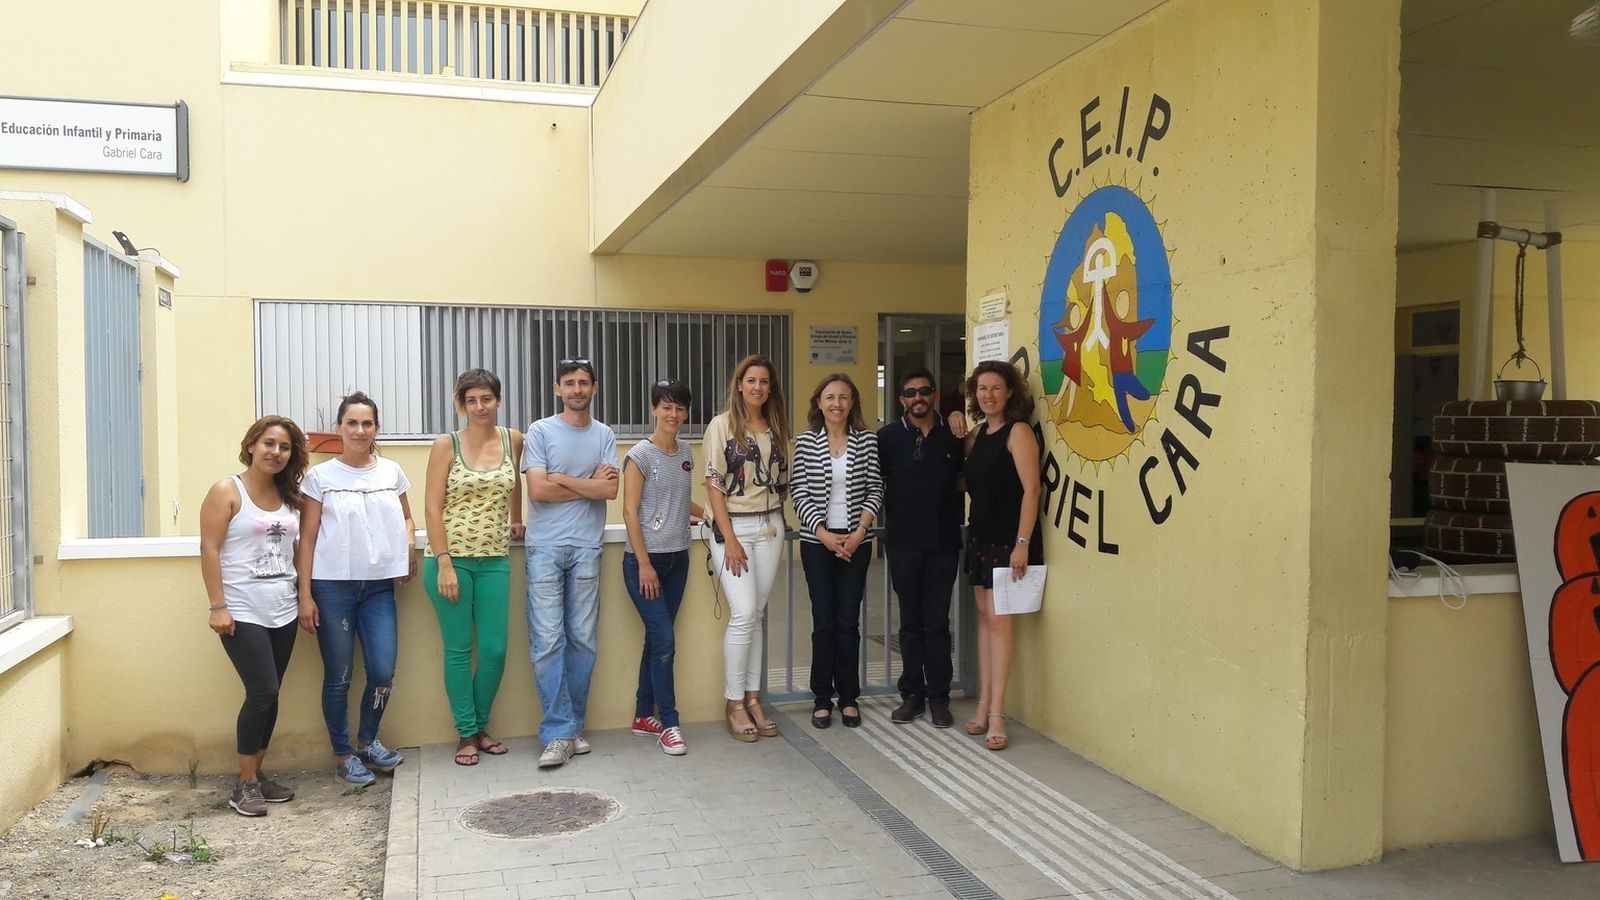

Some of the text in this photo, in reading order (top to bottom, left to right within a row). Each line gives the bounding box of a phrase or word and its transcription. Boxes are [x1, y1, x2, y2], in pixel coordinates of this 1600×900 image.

[1, 121, 162, 142] Educación Infantil y Primaria
[102, 145, 162, 160] Gabriel Cara
[1048, 86, 1171, 198] C.E.I.P.
[1139, 325, 1230, 525] CARA
